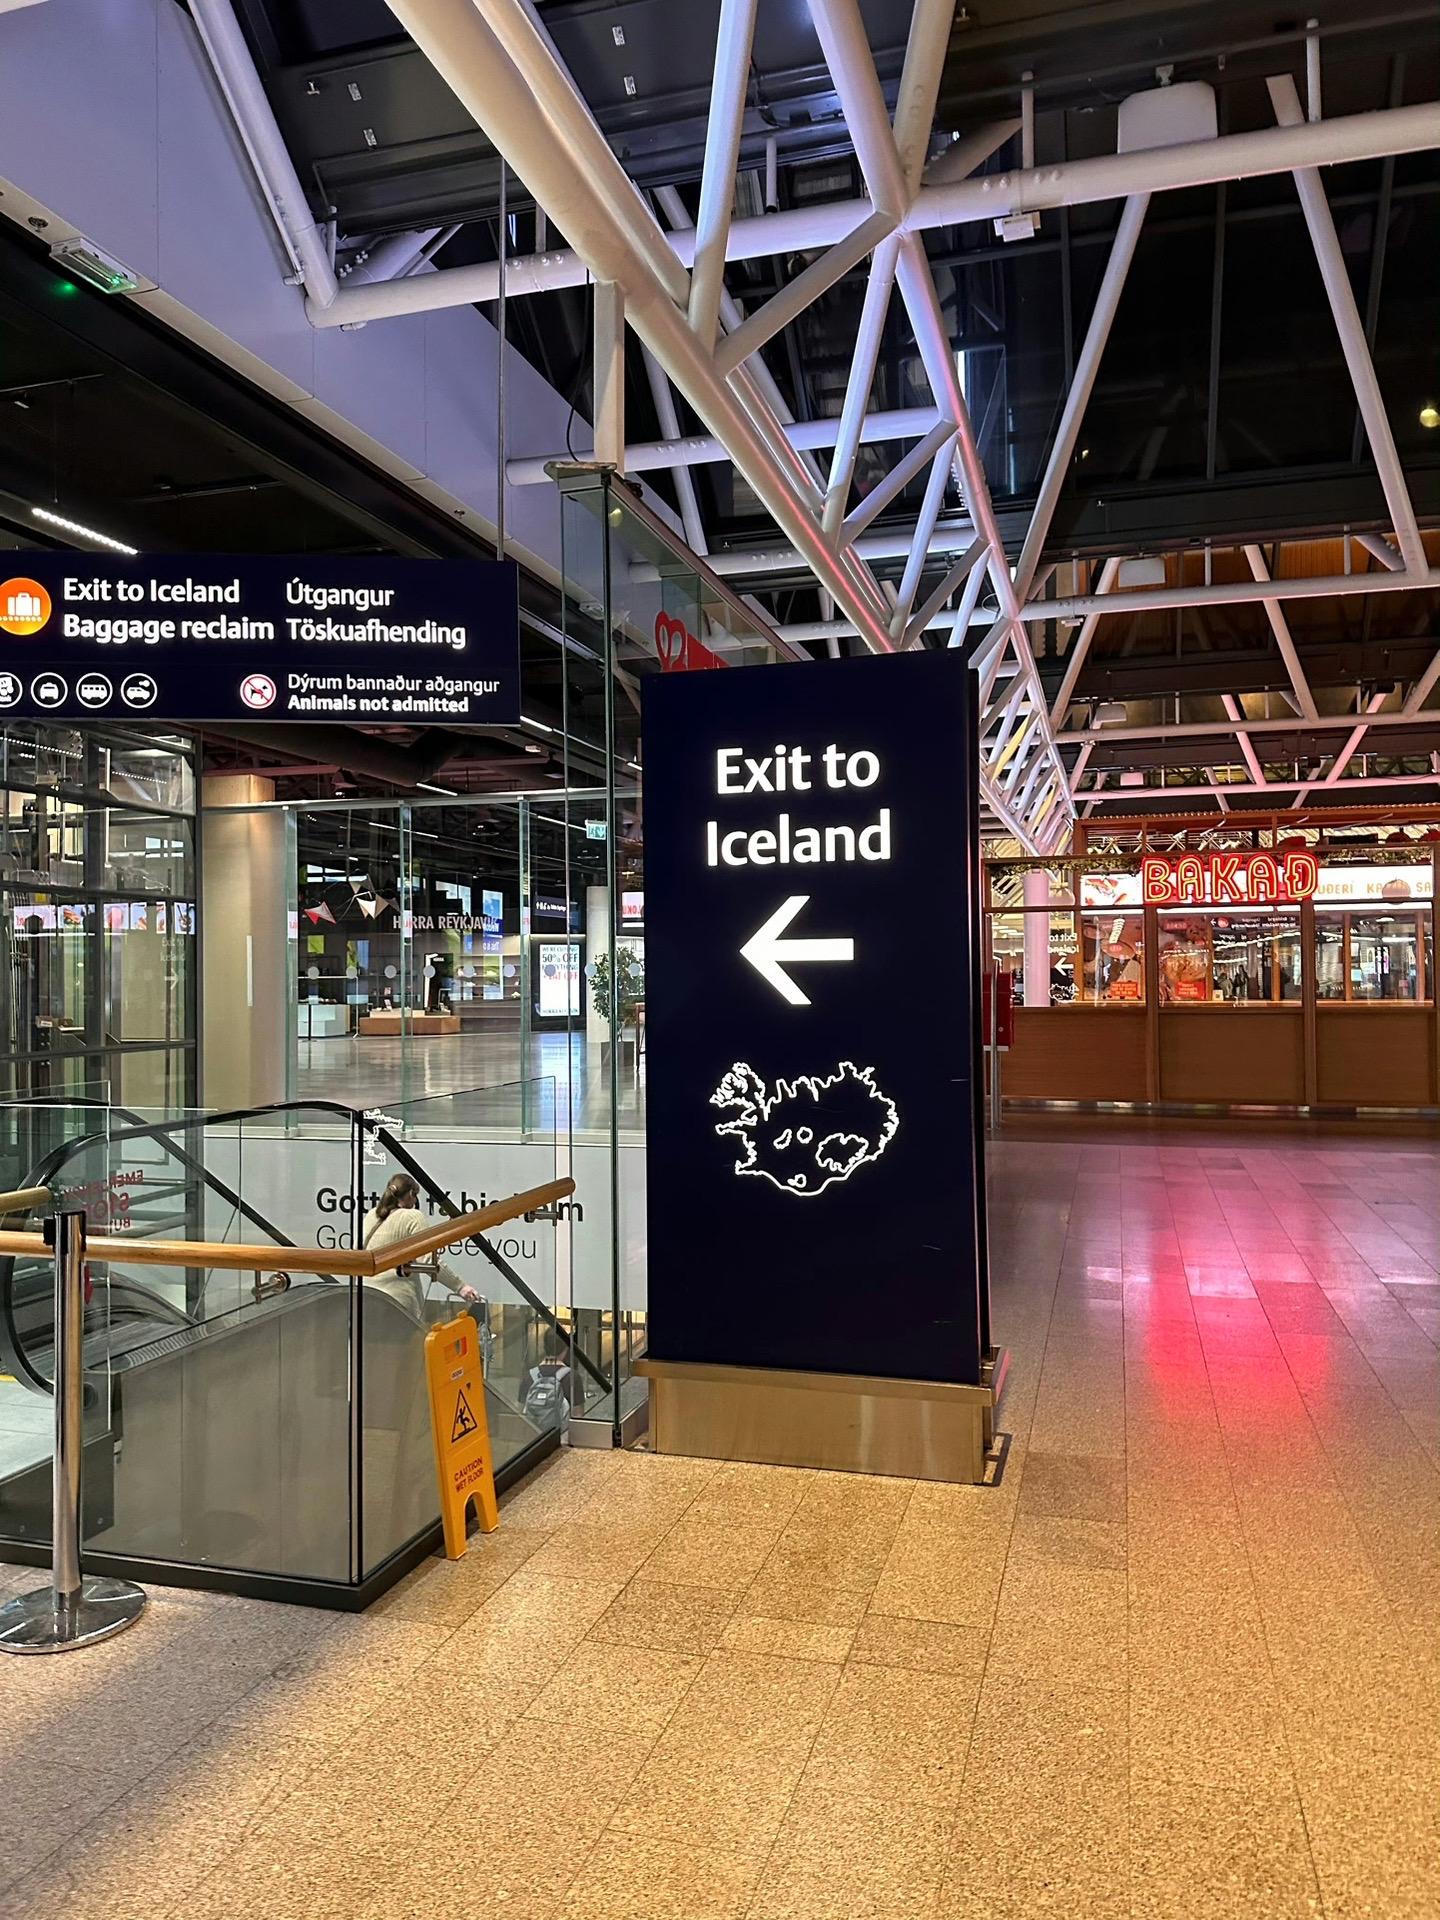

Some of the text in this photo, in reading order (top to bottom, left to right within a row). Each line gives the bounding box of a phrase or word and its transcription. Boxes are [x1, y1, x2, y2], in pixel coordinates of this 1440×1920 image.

[64, 578, 240, 603] Exit to Iceland
[286, 577, 395, 611] Útgangur
[63, 613, 275, 644] Baggage reclaim
[285, 617, 466, 649] Töskuafhending
[288, 673, 500, 696] Dýrum bannaður aðgangur
[287, 695, 469, 712] Animals not admitted
[717, 743, 880, 794] Exit to
[707, 808, 891, 867] Iceland
[1143, 853, 1319, 903] BAKAÐ
[393, 915, 434, 929] HRRA
[454, 1456, 483, 1482] CAUTION
[455, 1467, 483, 1493] WET FLOOR
